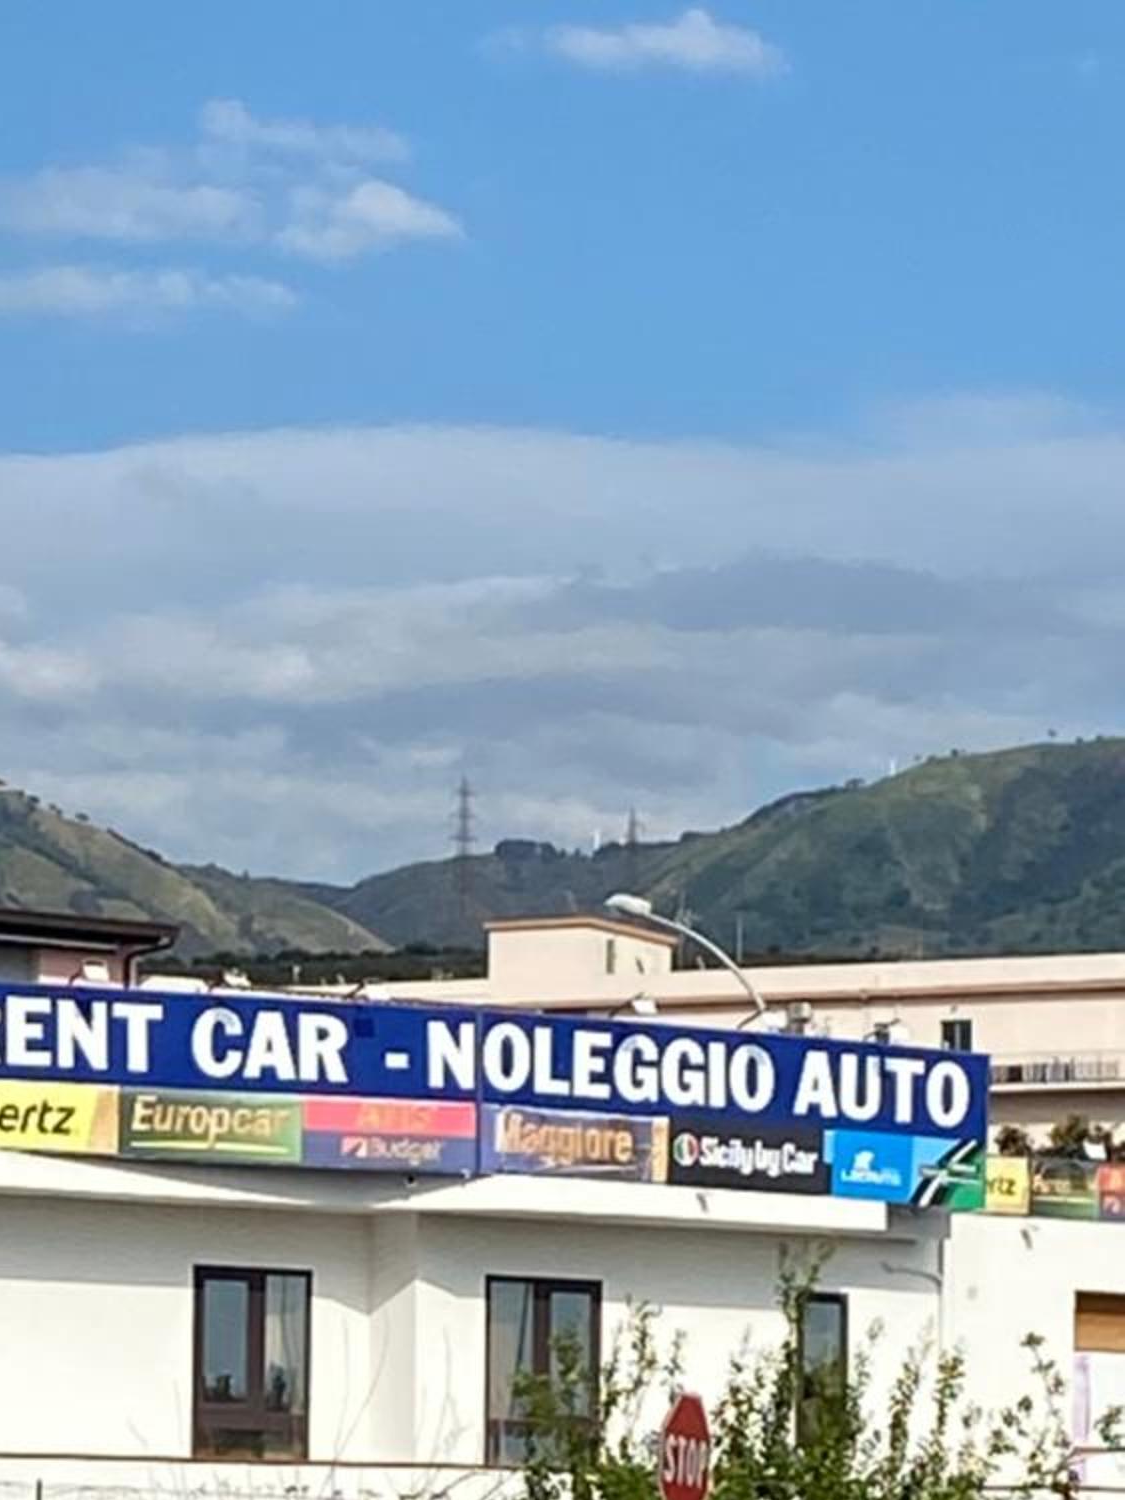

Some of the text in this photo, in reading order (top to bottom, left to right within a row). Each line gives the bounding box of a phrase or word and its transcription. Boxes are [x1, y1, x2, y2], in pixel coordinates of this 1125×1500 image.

[191, 1006, 349, 1083] CAR
[427, 1020, 774, 1112] NOLEGGIO
[794, 1051, 971, 1129] AUTO
[131, 1094, 285, 1149] Europcar
[497, 1113, 633, 1167] Maggiore
[986, 1177, 1016, 1195] rtz
[664, 1434, 707, 1488] STOP
